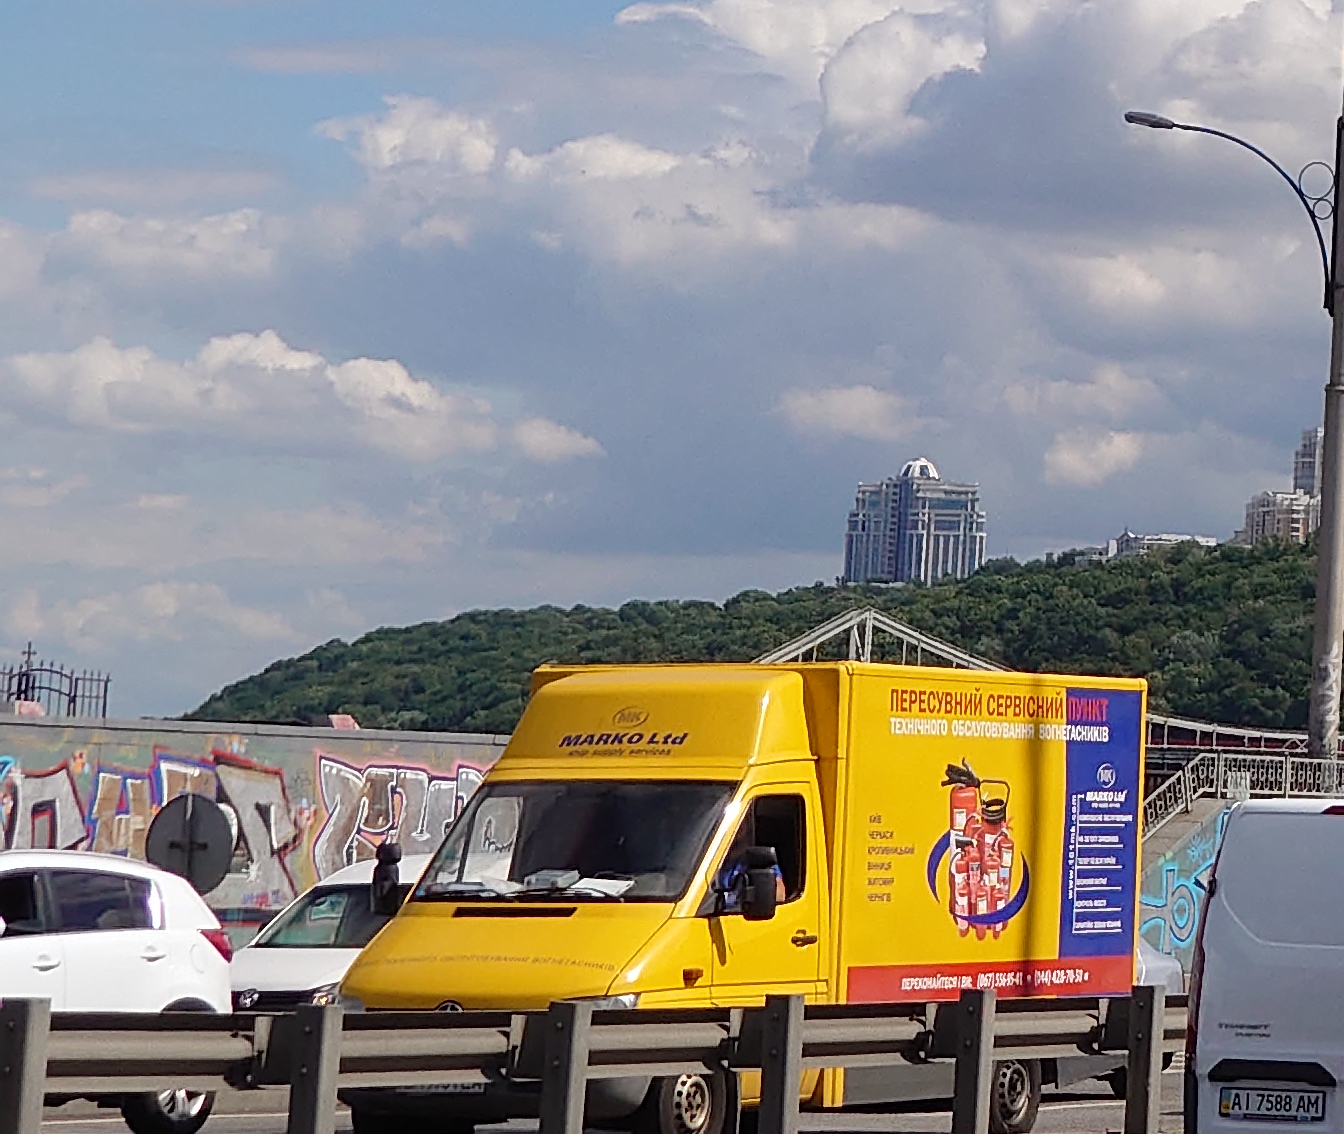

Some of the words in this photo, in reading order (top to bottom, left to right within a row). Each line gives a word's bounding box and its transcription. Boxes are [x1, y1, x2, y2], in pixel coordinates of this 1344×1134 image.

[890, 686, 983, 716] ПЕРЕСУВНИЙ
[986, 691, 1064, 719] СЕРВІСНИЙ
[1068, 696, 1109, 722] ПУНКТ
[559, 732, 645, 747] MARKO
[647, 732, 689, 745] Ltd
[890, 717, 948, 736] ТЕХНІЧНОГО
[1038, 723, 1109, 743] ВОГНЕГАСНИКІВ
[1231, 1092, 1250, 1111] AI
[1256, 1093, 1293, 1113] 7588
[1295, 1095, 1320, 1114] AM
